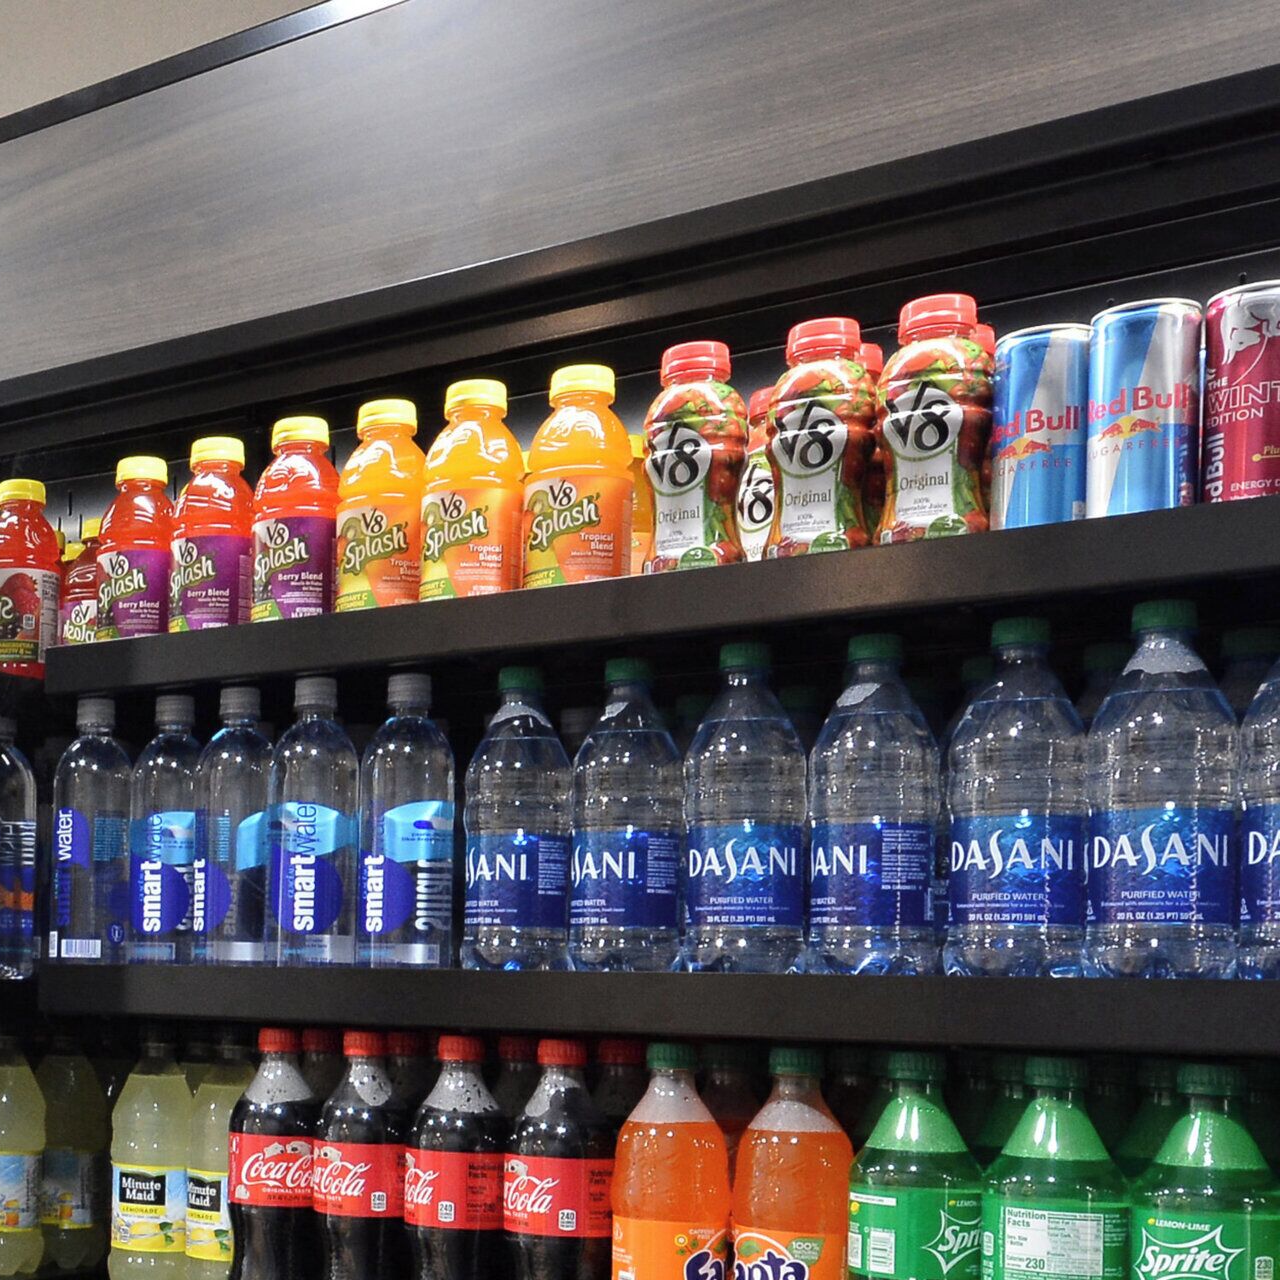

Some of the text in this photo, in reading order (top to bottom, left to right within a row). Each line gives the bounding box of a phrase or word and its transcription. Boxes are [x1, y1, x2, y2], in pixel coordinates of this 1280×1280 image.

[1132, 383, 1189, 411] Bull
[1208, 377, 1228, 389] THE
[1208, 381, 1280, 414] WIN
[884, 381, 952, 451] V8
[1025, 406, 1080, 435] Bull
[775, 400, 837, 469] V8
[1091, 437, 1182, 460] UGARFREE
[646, 421, 702, 487] V8
[998, 458, 1073, 477] GARFREE
[548, 480, 573, 508] V8
[900, 471, 949, 491] Original
[1230, 480, 1272, 492] ENERGY
[440, 493, 465, 521] V8
[785, 488, 832, 507] Original
[361, 509, 385, 534] V8
[531, 499, 600, 545] Splash
[658, 508, 701, 525] Original
[266, 524, 286, 546] V8
[425, 510, 488, 555] Splash
[178, 543, 195, 564] V8
[254, 537, 309, 582] Splash
[344, 529, 407, 570] Splash
[109, 554, 128, 578] V8
[170, 556, 216, 597] Splash
[99, 569, 146, 608] Splash
[689, 838, 796, 884] DASANI
[811, 840, 868, 883] ANI
[951, 829, 1073, 880] DASANI
[1093, 824, 1228, 876] DASANI
[293, 804, 318, 932] smart wate
[466, 847, 528, 888] SANI
[571, 845, 635, 888] SANI
[142, 860, 162, 933] smart
[193, 858, 206, 932] smart
[364, 854, 385, 933] smart
[972, 893, 1044, 901] PURIFIED WATER
[1121, 890, 1165, 899] PURIFIED
[121, 1176, 162, 1191] Minute
[241, 1152, 315, 1188] Coca-Co
[314, 1160, 372, 1198] -Cola
[125, 1188, 155, 1201] Maid
[559, 1211, 575, 1221] 240
[1006, 1208, 1046, 1220] Nutrition
[1007, 1218, 1031, 1228] Facts
[1155, 1218, 1211, 1232] LEMON-LIME
[937, 1225, 982, 1255] Spri
[1025, 1257, 1046, 1270] 230
[1140, 1245, 1226, 1277] Sprite
